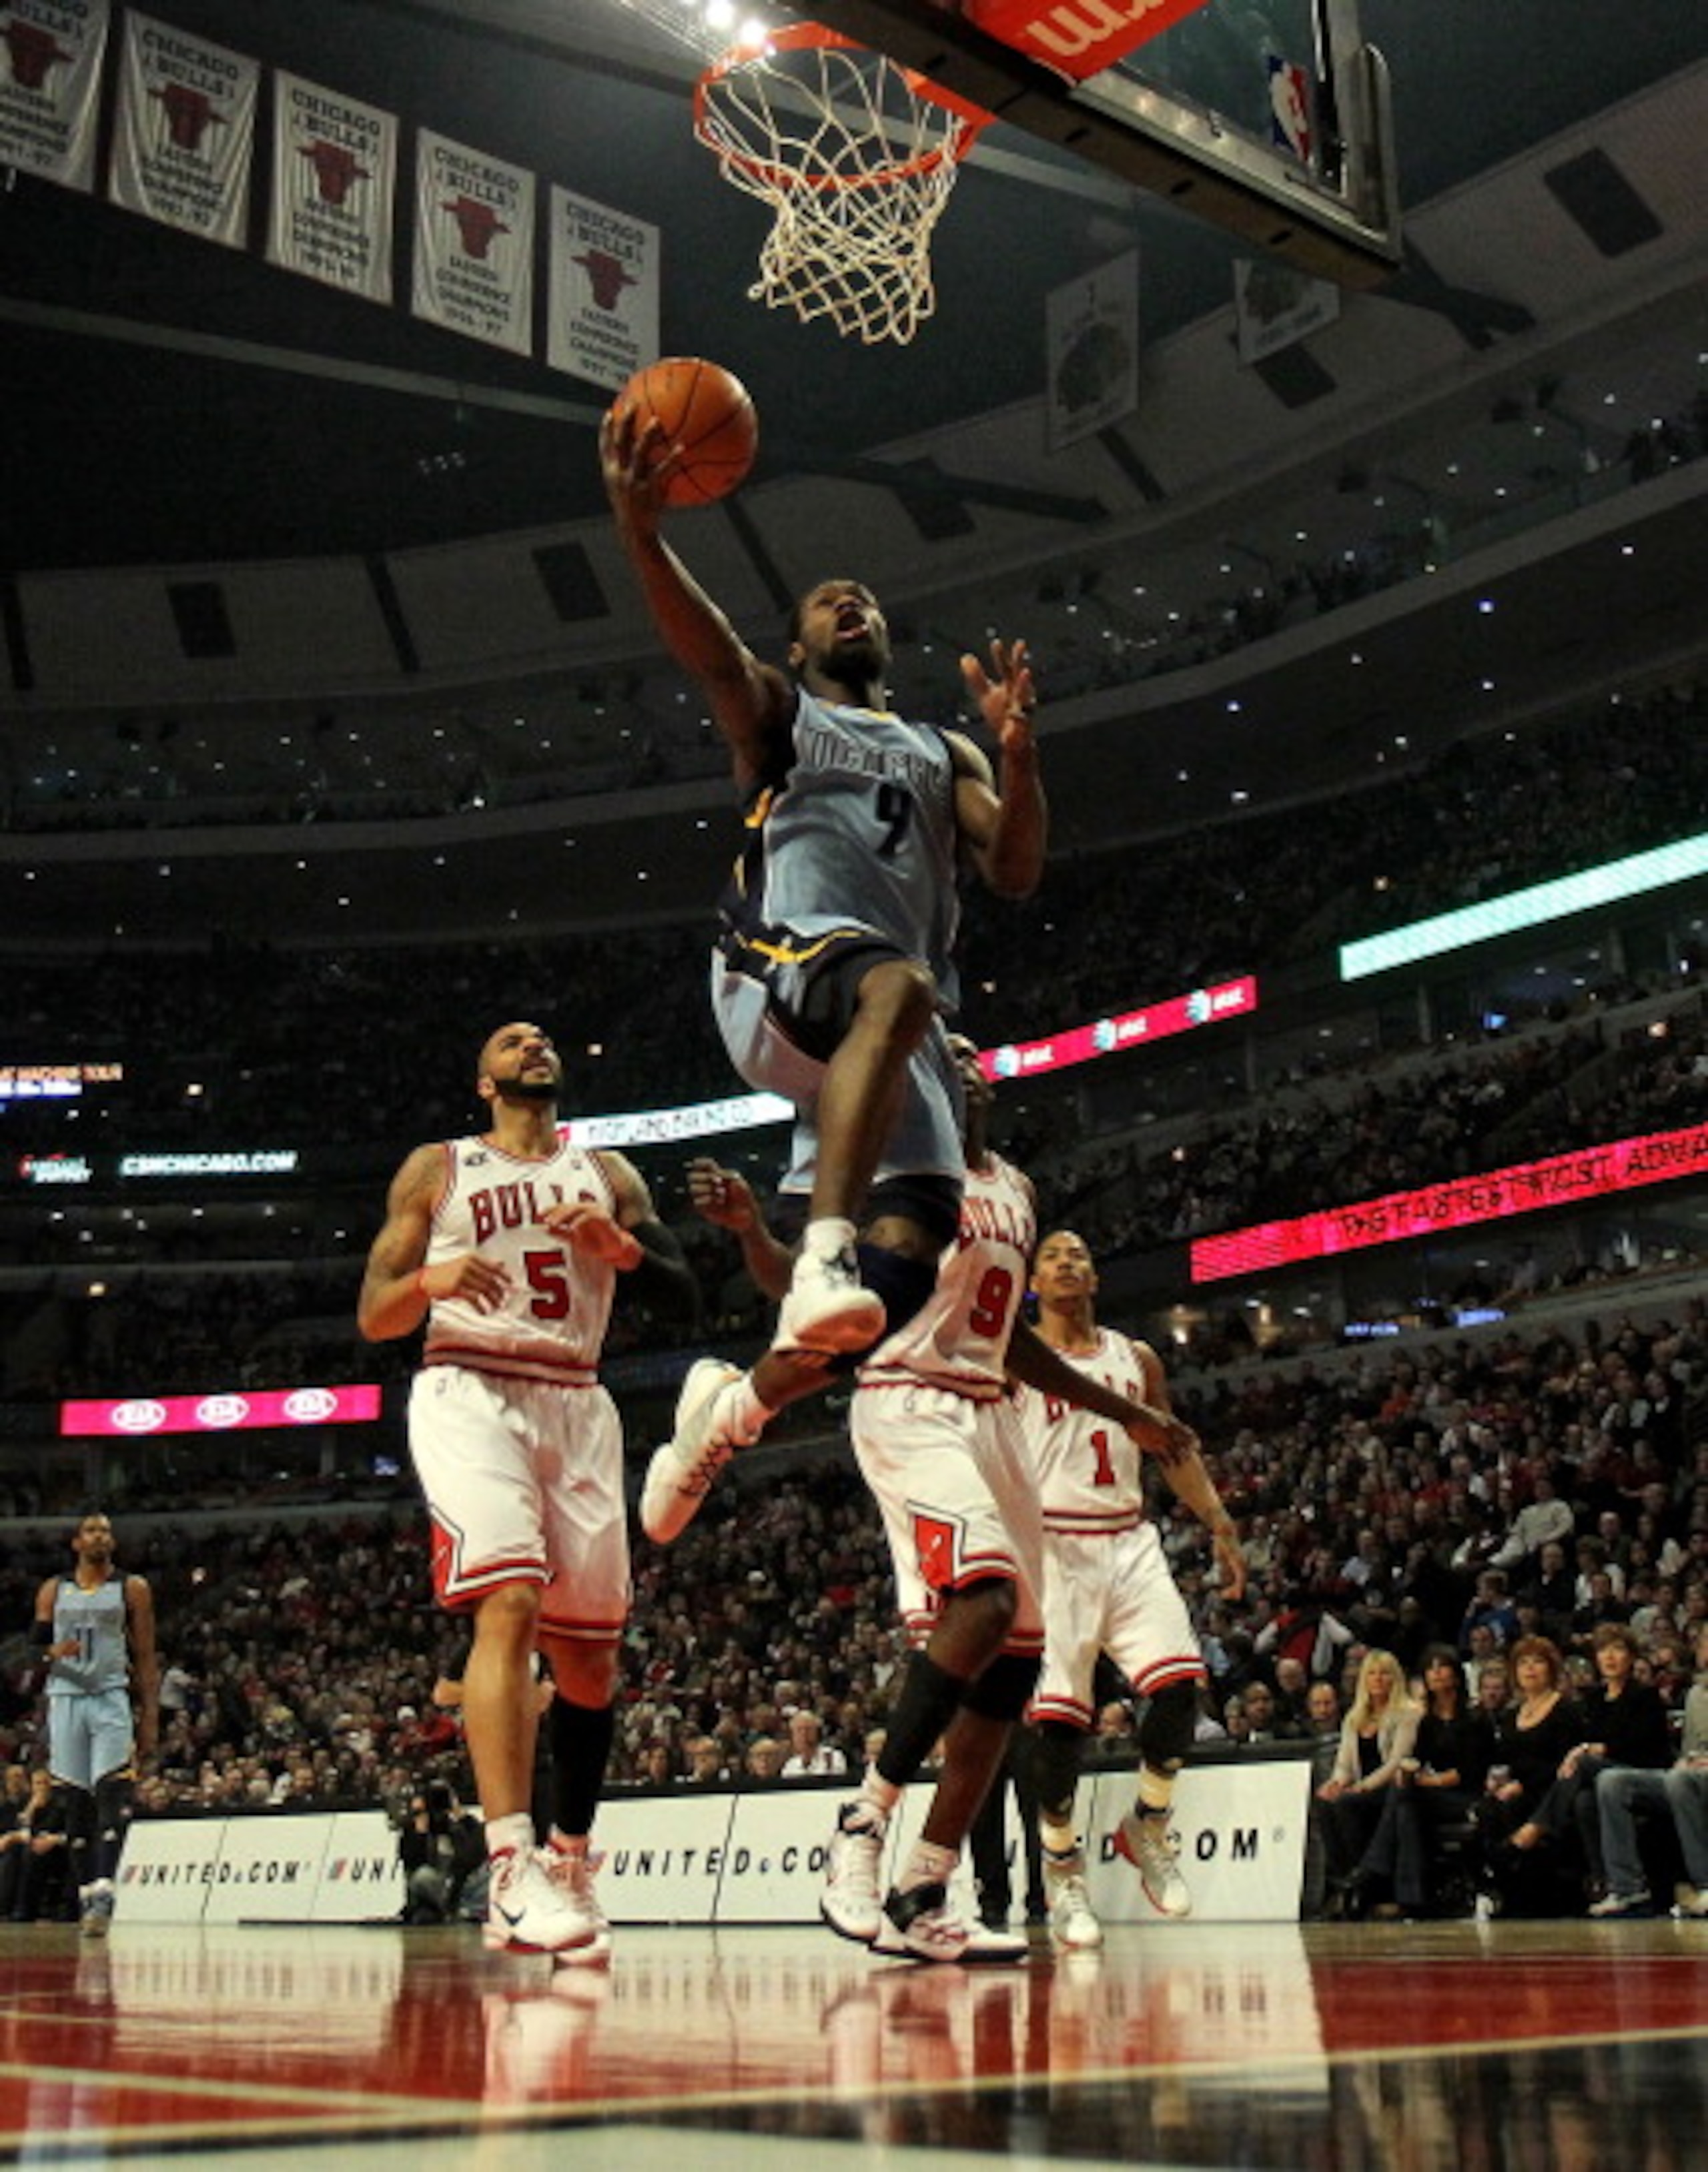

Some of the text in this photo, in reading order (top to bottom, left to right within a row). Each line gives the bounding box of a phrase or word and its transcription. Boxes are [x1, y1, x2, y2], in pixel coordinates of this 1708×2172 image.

[143, 29, 238, 81] CHICAGO
[157, 57, 224, 95] BULLS
[292, 89, 380, 135] CHICAGO
[307, 115, 367, 151] BULLS
[435, 147, 520, 193] CHICAGO
[448, 172, 506, 207] BULLS
[567, 202, 645, 245] CHICAGO
[578, 223, 632, 259] BULLS
[877, 782, 913, 861] 9
[524, 1251, 570, 1319] 5
[971, 1267, 1012, 1337] 9
[1091, 1430, 1116, 1487] 1
